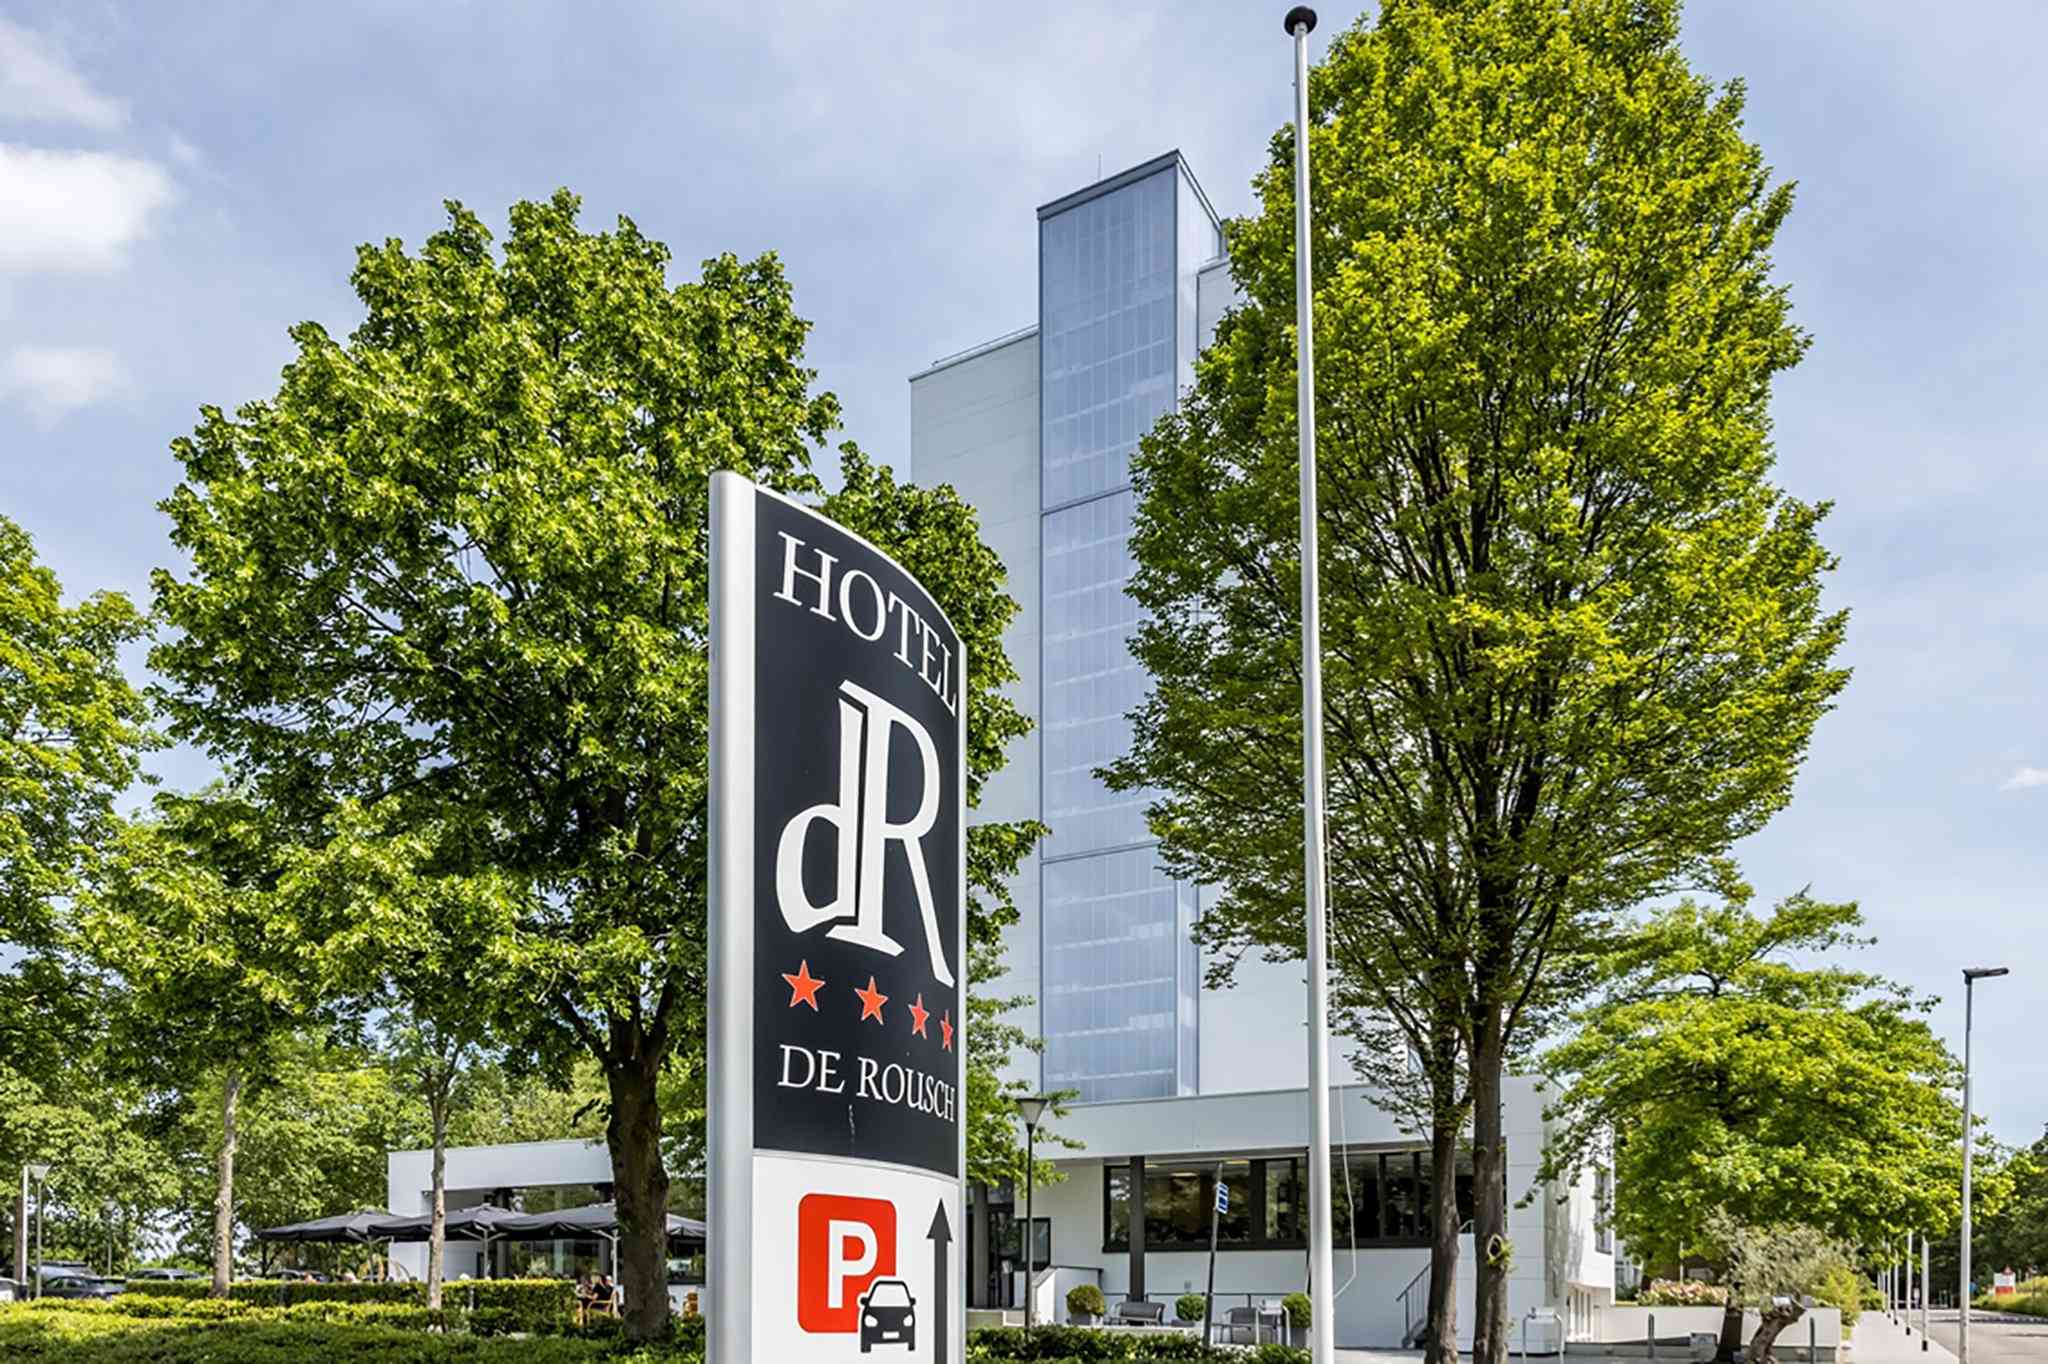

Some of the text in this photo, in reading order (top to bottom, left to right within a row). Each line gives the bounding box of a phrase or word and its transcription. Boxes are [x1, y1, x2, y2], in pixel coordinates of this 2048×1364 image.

[773, 531, 957, 716] HOTEL
[777, 1044, 955, 1122] DE ROUSCH
[828, 1219, 878, 1309] P
